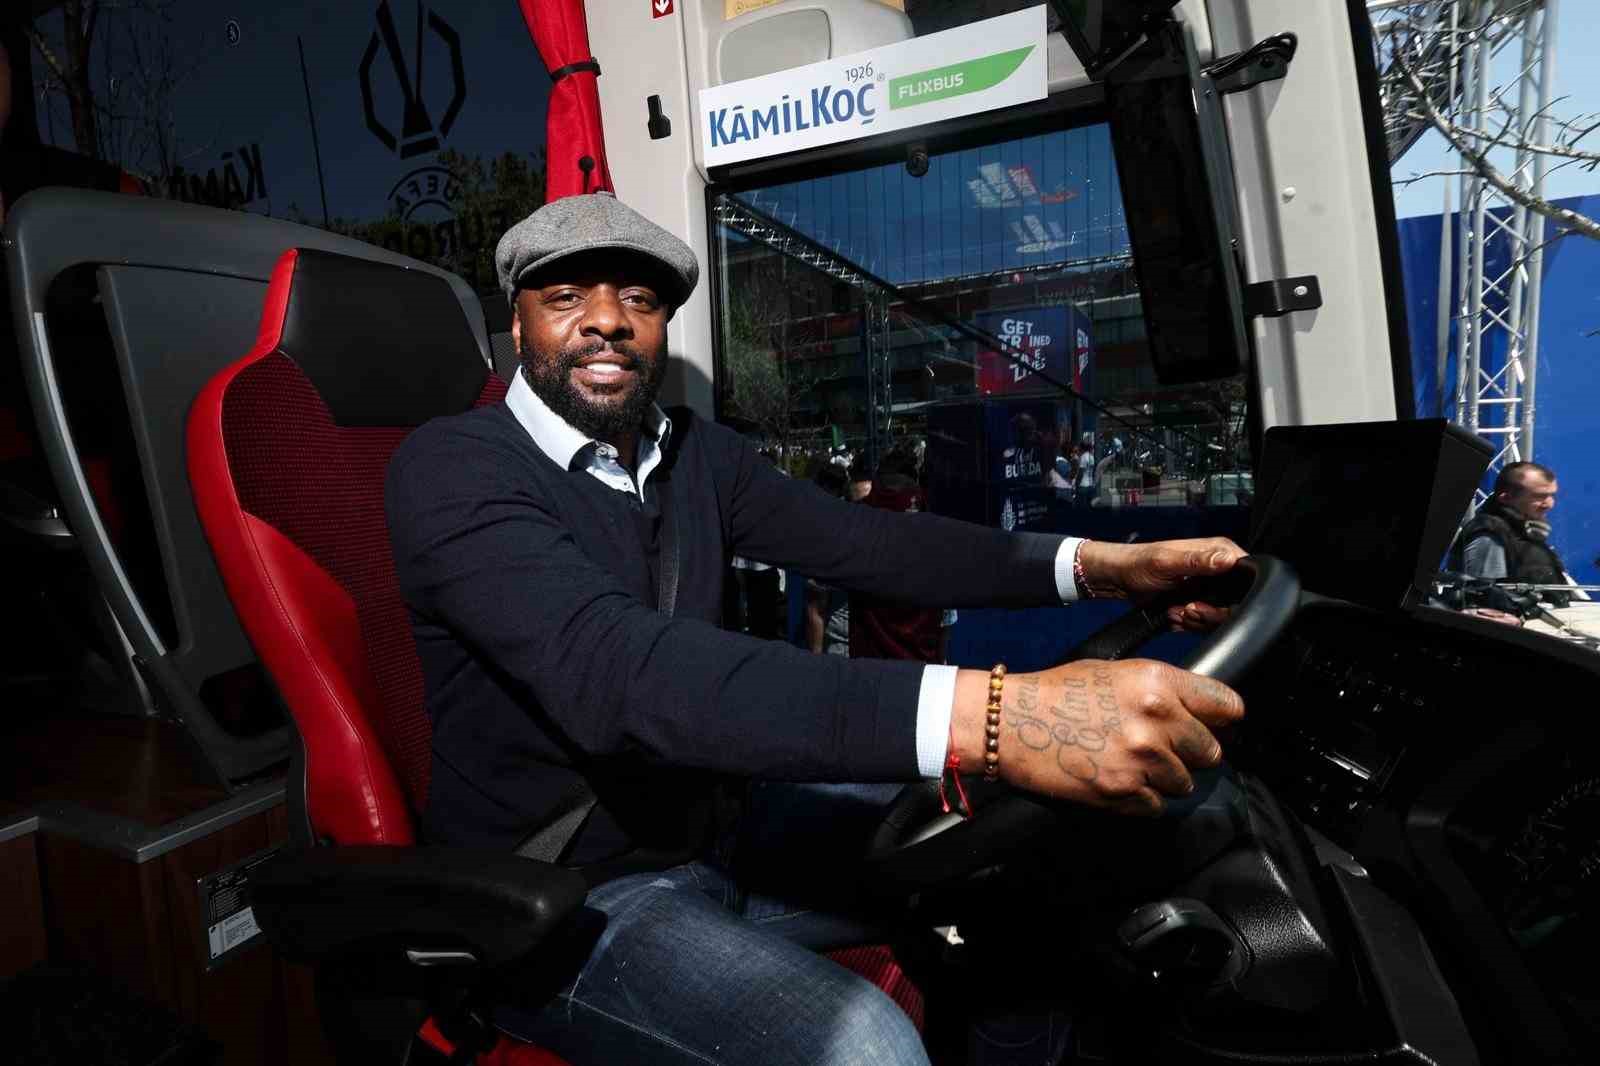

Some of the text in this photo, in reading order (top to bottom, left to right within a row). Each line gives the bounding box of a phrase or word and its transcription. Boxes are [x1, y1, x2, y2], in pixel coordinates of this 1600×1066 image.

[845, 62, 874, 84] 1926
[898, 72, 965, 100] FLIXBUS
[1001, 318, 1034, 335] GET
